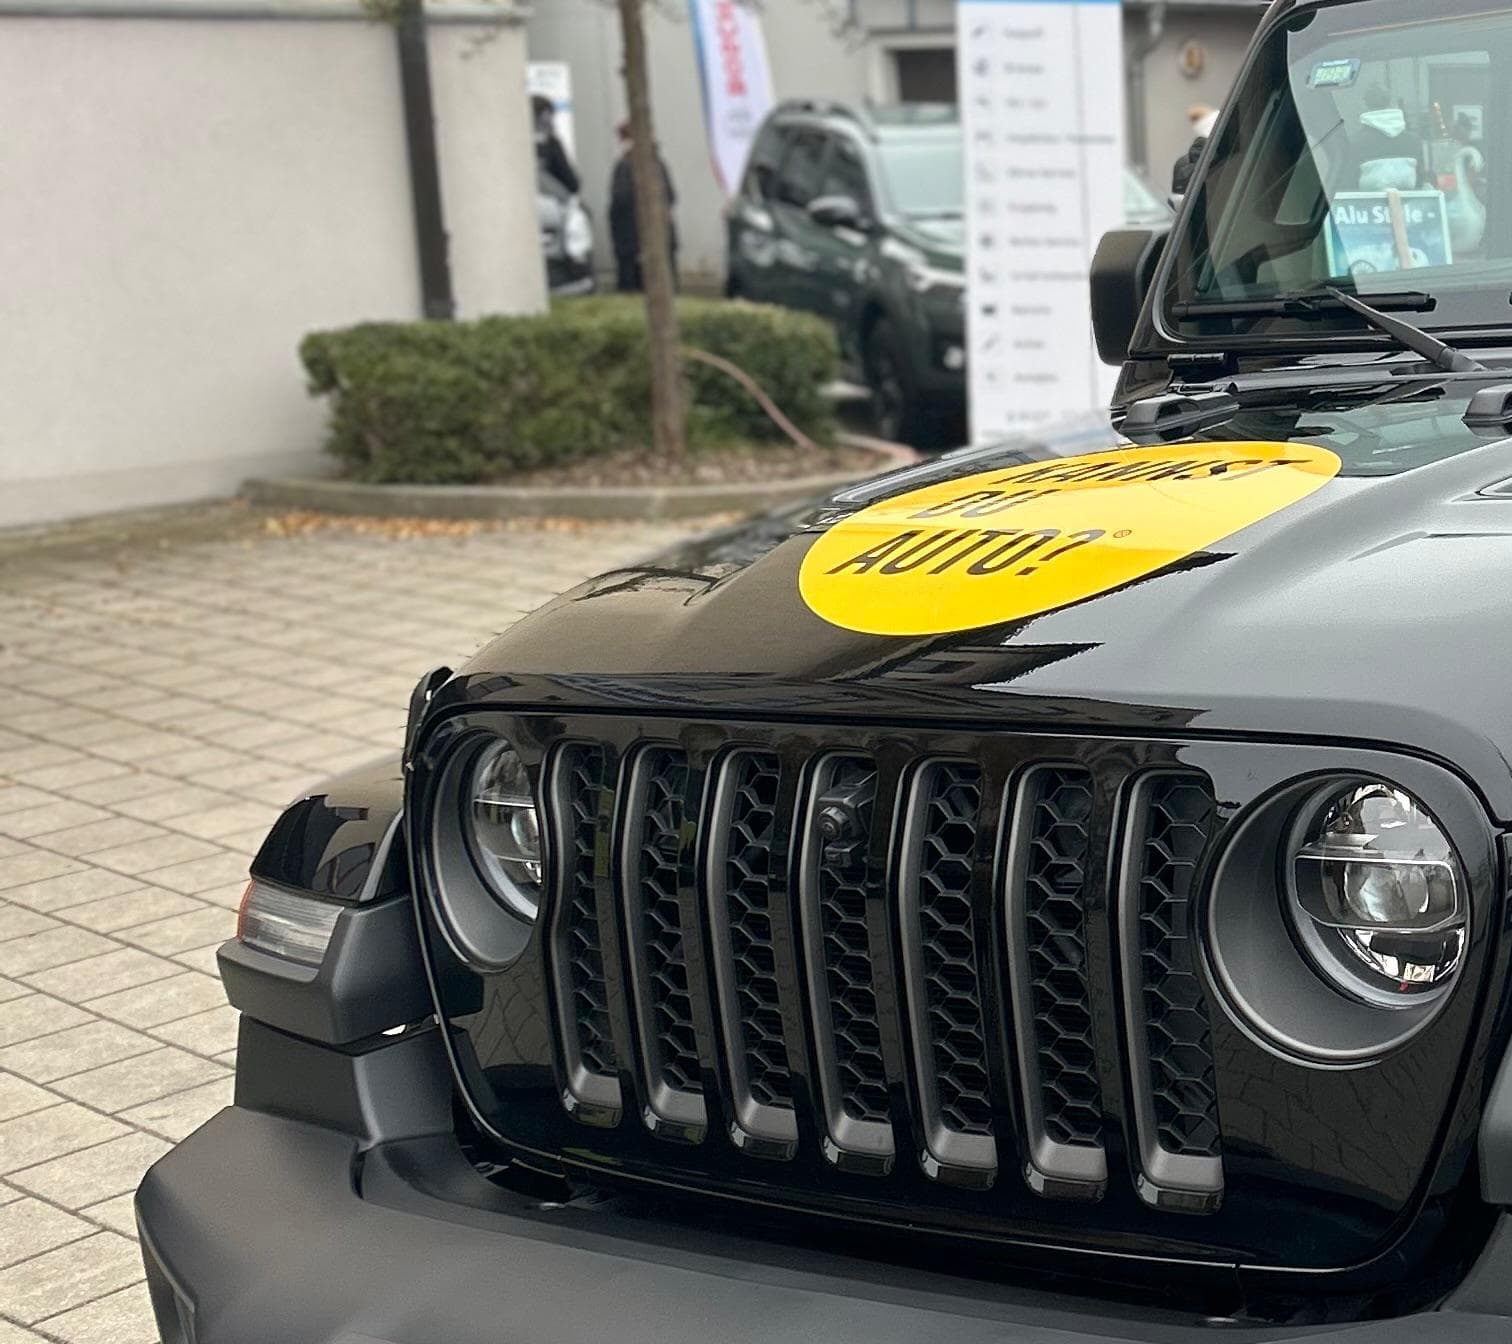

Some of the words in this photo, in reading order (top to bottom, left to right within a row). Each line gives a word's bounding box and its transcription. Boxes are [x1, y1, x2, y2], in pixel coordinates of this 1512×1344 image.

[1334, 205, 1369, 225] Alu
[1372, 204, 1424, 225] Stle
[905, 488, 1062, 520] DU
[824, 528, 1107, 576] AUTO?
